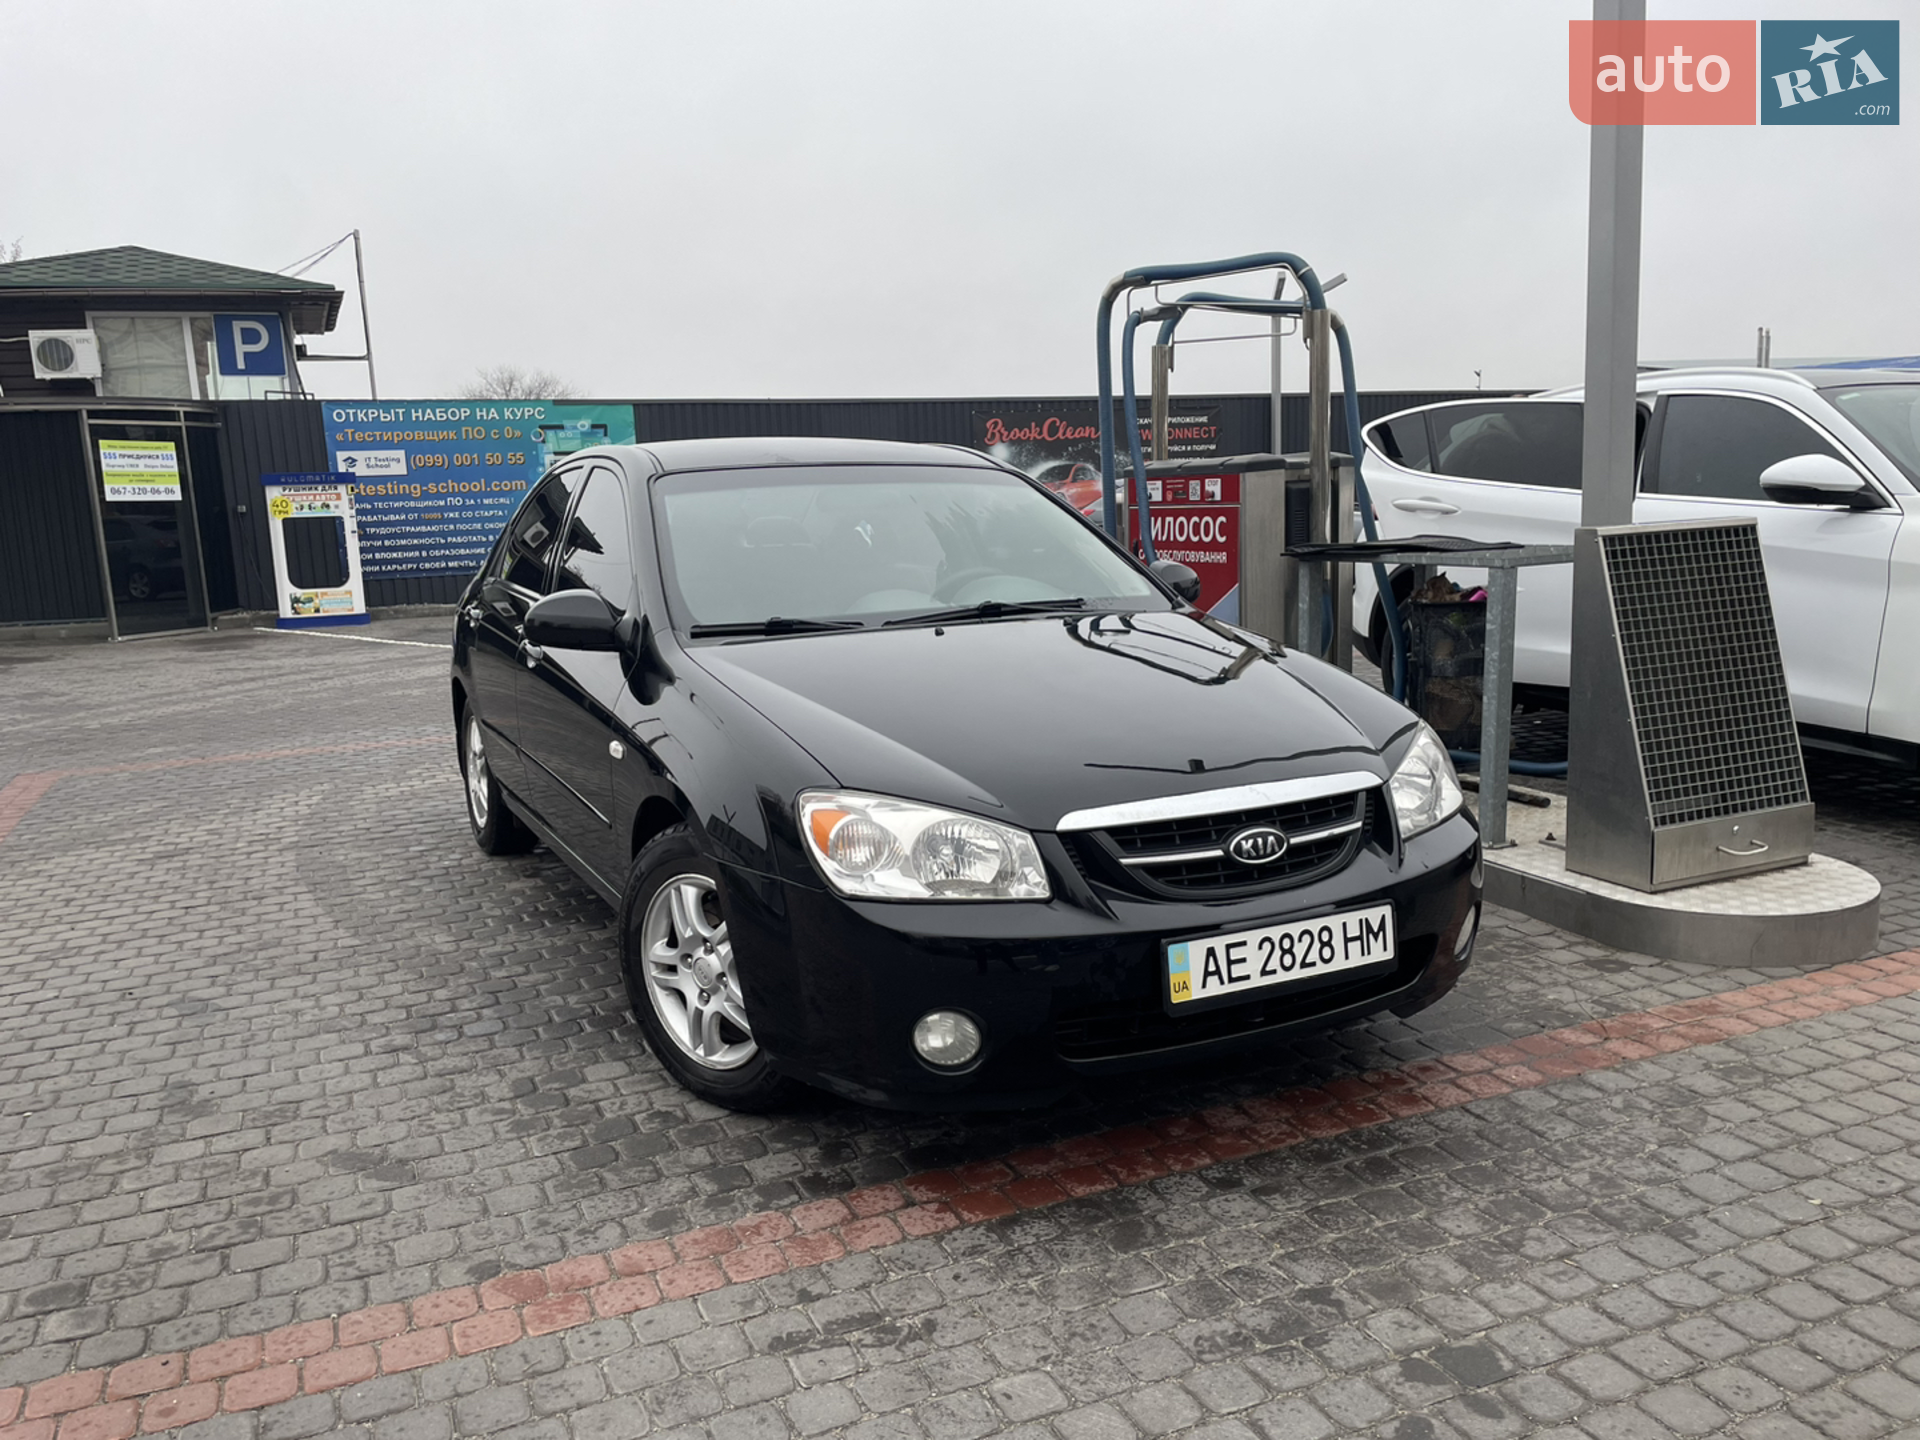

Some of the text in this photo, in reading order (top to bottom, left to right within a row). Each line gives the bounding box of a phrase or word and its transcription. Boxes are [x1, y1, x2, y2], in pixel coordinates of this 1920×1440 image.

[232, 320, 270, 370] P
[332, 407, 546, 423] ОТКРЫТ НАБОР НА КУРС
[1167, 415, 1209, 424] РИЛОЖЕНИЕ
[335, 428, 458, 445] «Тестировщик
[462, 426, 486, 441] ПО
[504, 426, 522, 440] 0»
[984, 416, 1101, 446] BrookClean
[366, 462, 391, 470] School
[372, 455, 401, 464] Testing
[411, 452, 526, 471] (099) 001 50 55
[110, 486, 176, 496] 067-320-06-06
[321, 484, 339, 492] ДЛЯ
[354, 479, 527, 499] -testing-school.com
[272, 499, 289, 509] 40
[355, 502, 371, 510] АНЬ
[373, 499, 445, 509] ТЕСТИРОВЩИКОМ
[447, 496, 463, 506] ПО
[357, 512, 405, 522] РАБАТЫВАЙ
[407, 513, 419, 521] ОТ
[443, 511, 459, 519] УЖЕ
[475, 509, 503, 518] СТАРТА
[365, 524, 455, 535] ТРУДОУСТРАИВАЮТСЯ
[456, 523, 482, 532] ПОСЛЕ
[1140, 515, 1228, 544] ИЛОСОС
[384, 537, 445, 547] ВОЗМОЖНОСТЬ
[447, 535, 487, 544] РАБОТАТЬ
[375, 550, 420, 560] ВЛОЖЕНИЯ
[429, 547, 486, 557] ОБРАЗОВАНИЕ
[381, 562, 417, 572] КАРЬЕРУ
[419, 559, 446, 569] СВОЕЙ
[1240, 835, 1280, 858] KIA
[1201, 912, 1388, 990] AE 2828 HM
[1173, 980, 1190, 994] UA
